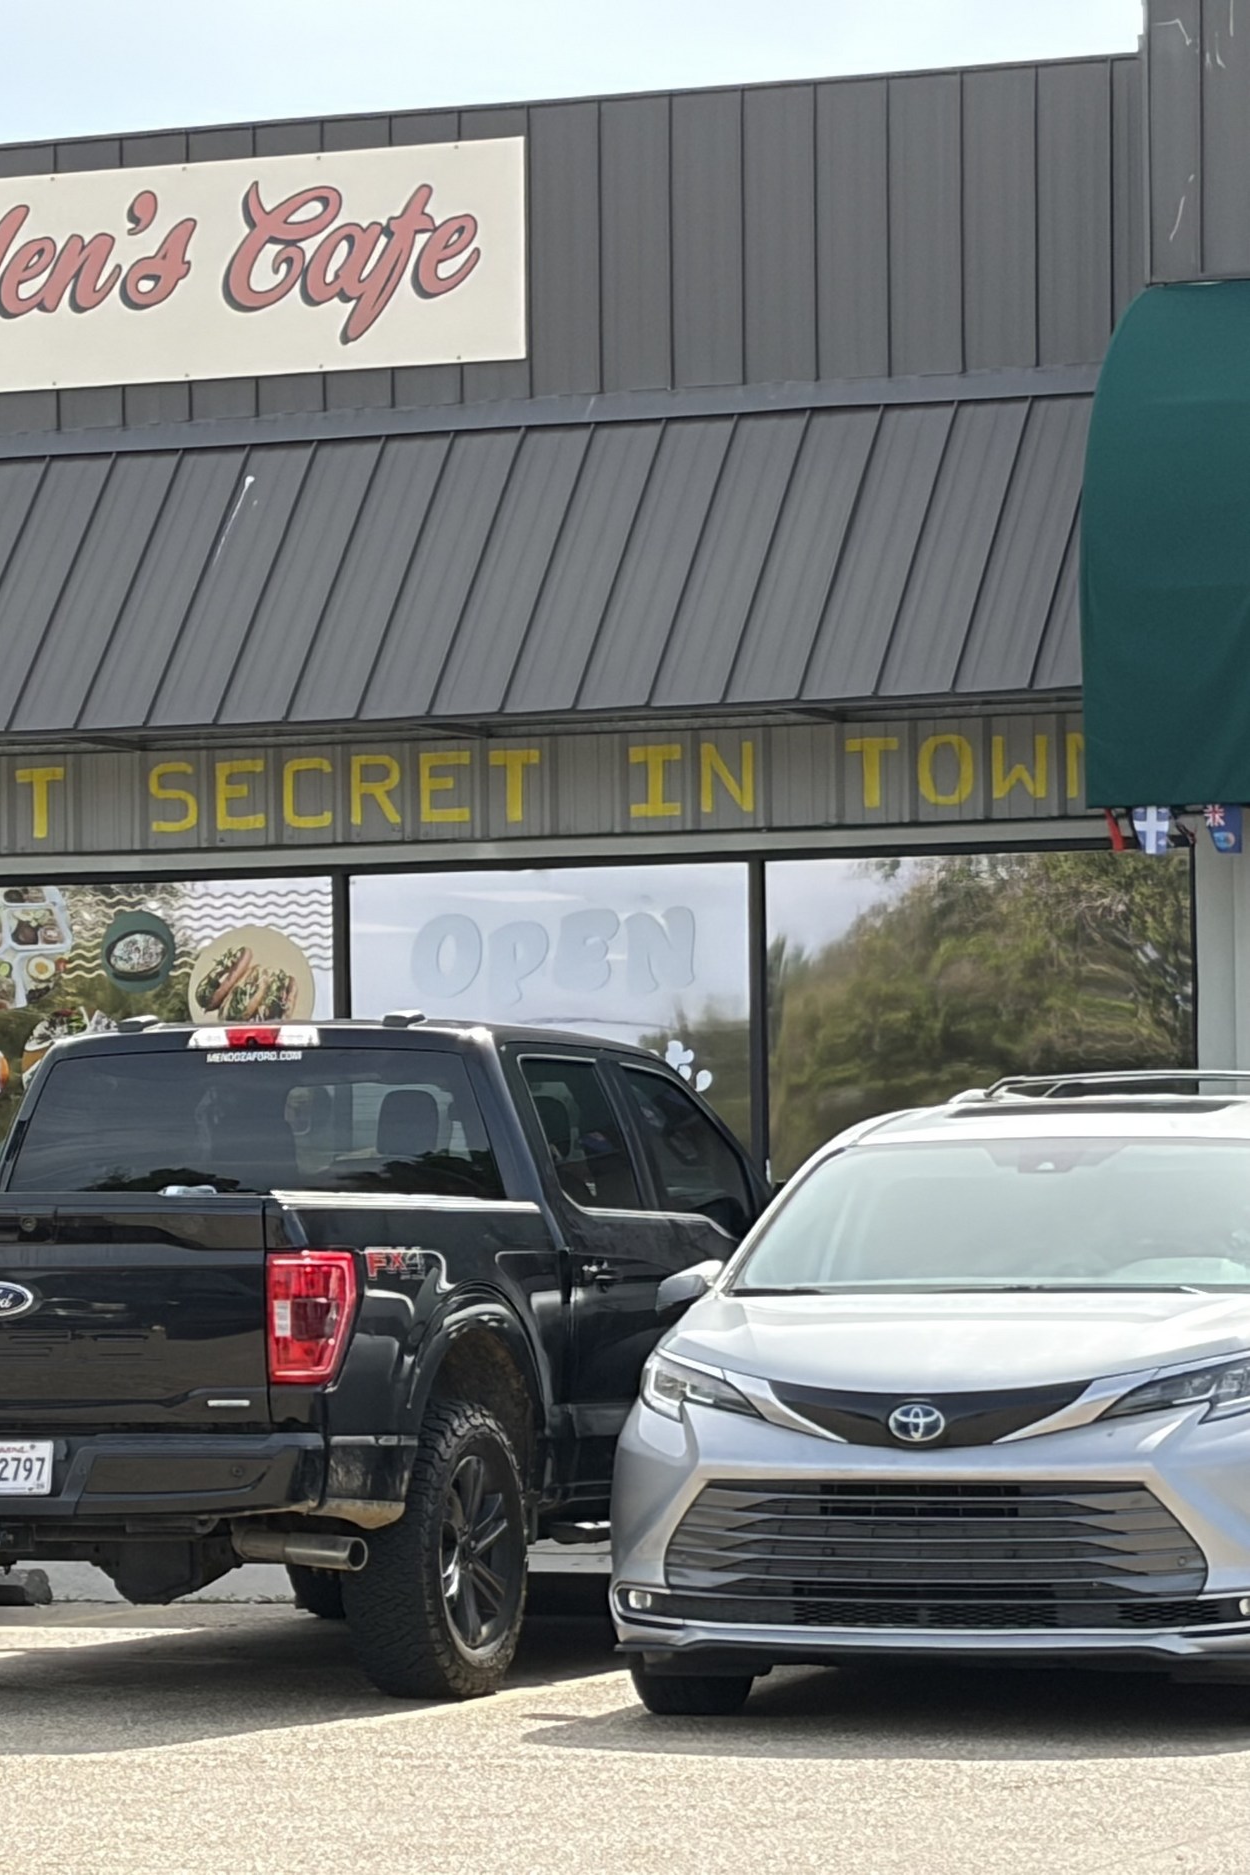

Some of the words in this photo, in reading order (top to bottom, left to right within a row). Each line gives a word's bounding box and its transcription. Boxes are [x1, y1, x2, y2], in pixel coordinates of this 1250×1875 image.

[223, 181, 480, 345] Cafe
[148, 749, 540, 832] SECRET
[628, 741, 754, 818] IN
[410, 905, 696, 1005] OPEN
[206, 1050, 302, 1063] MENDOZAFORD.COM
